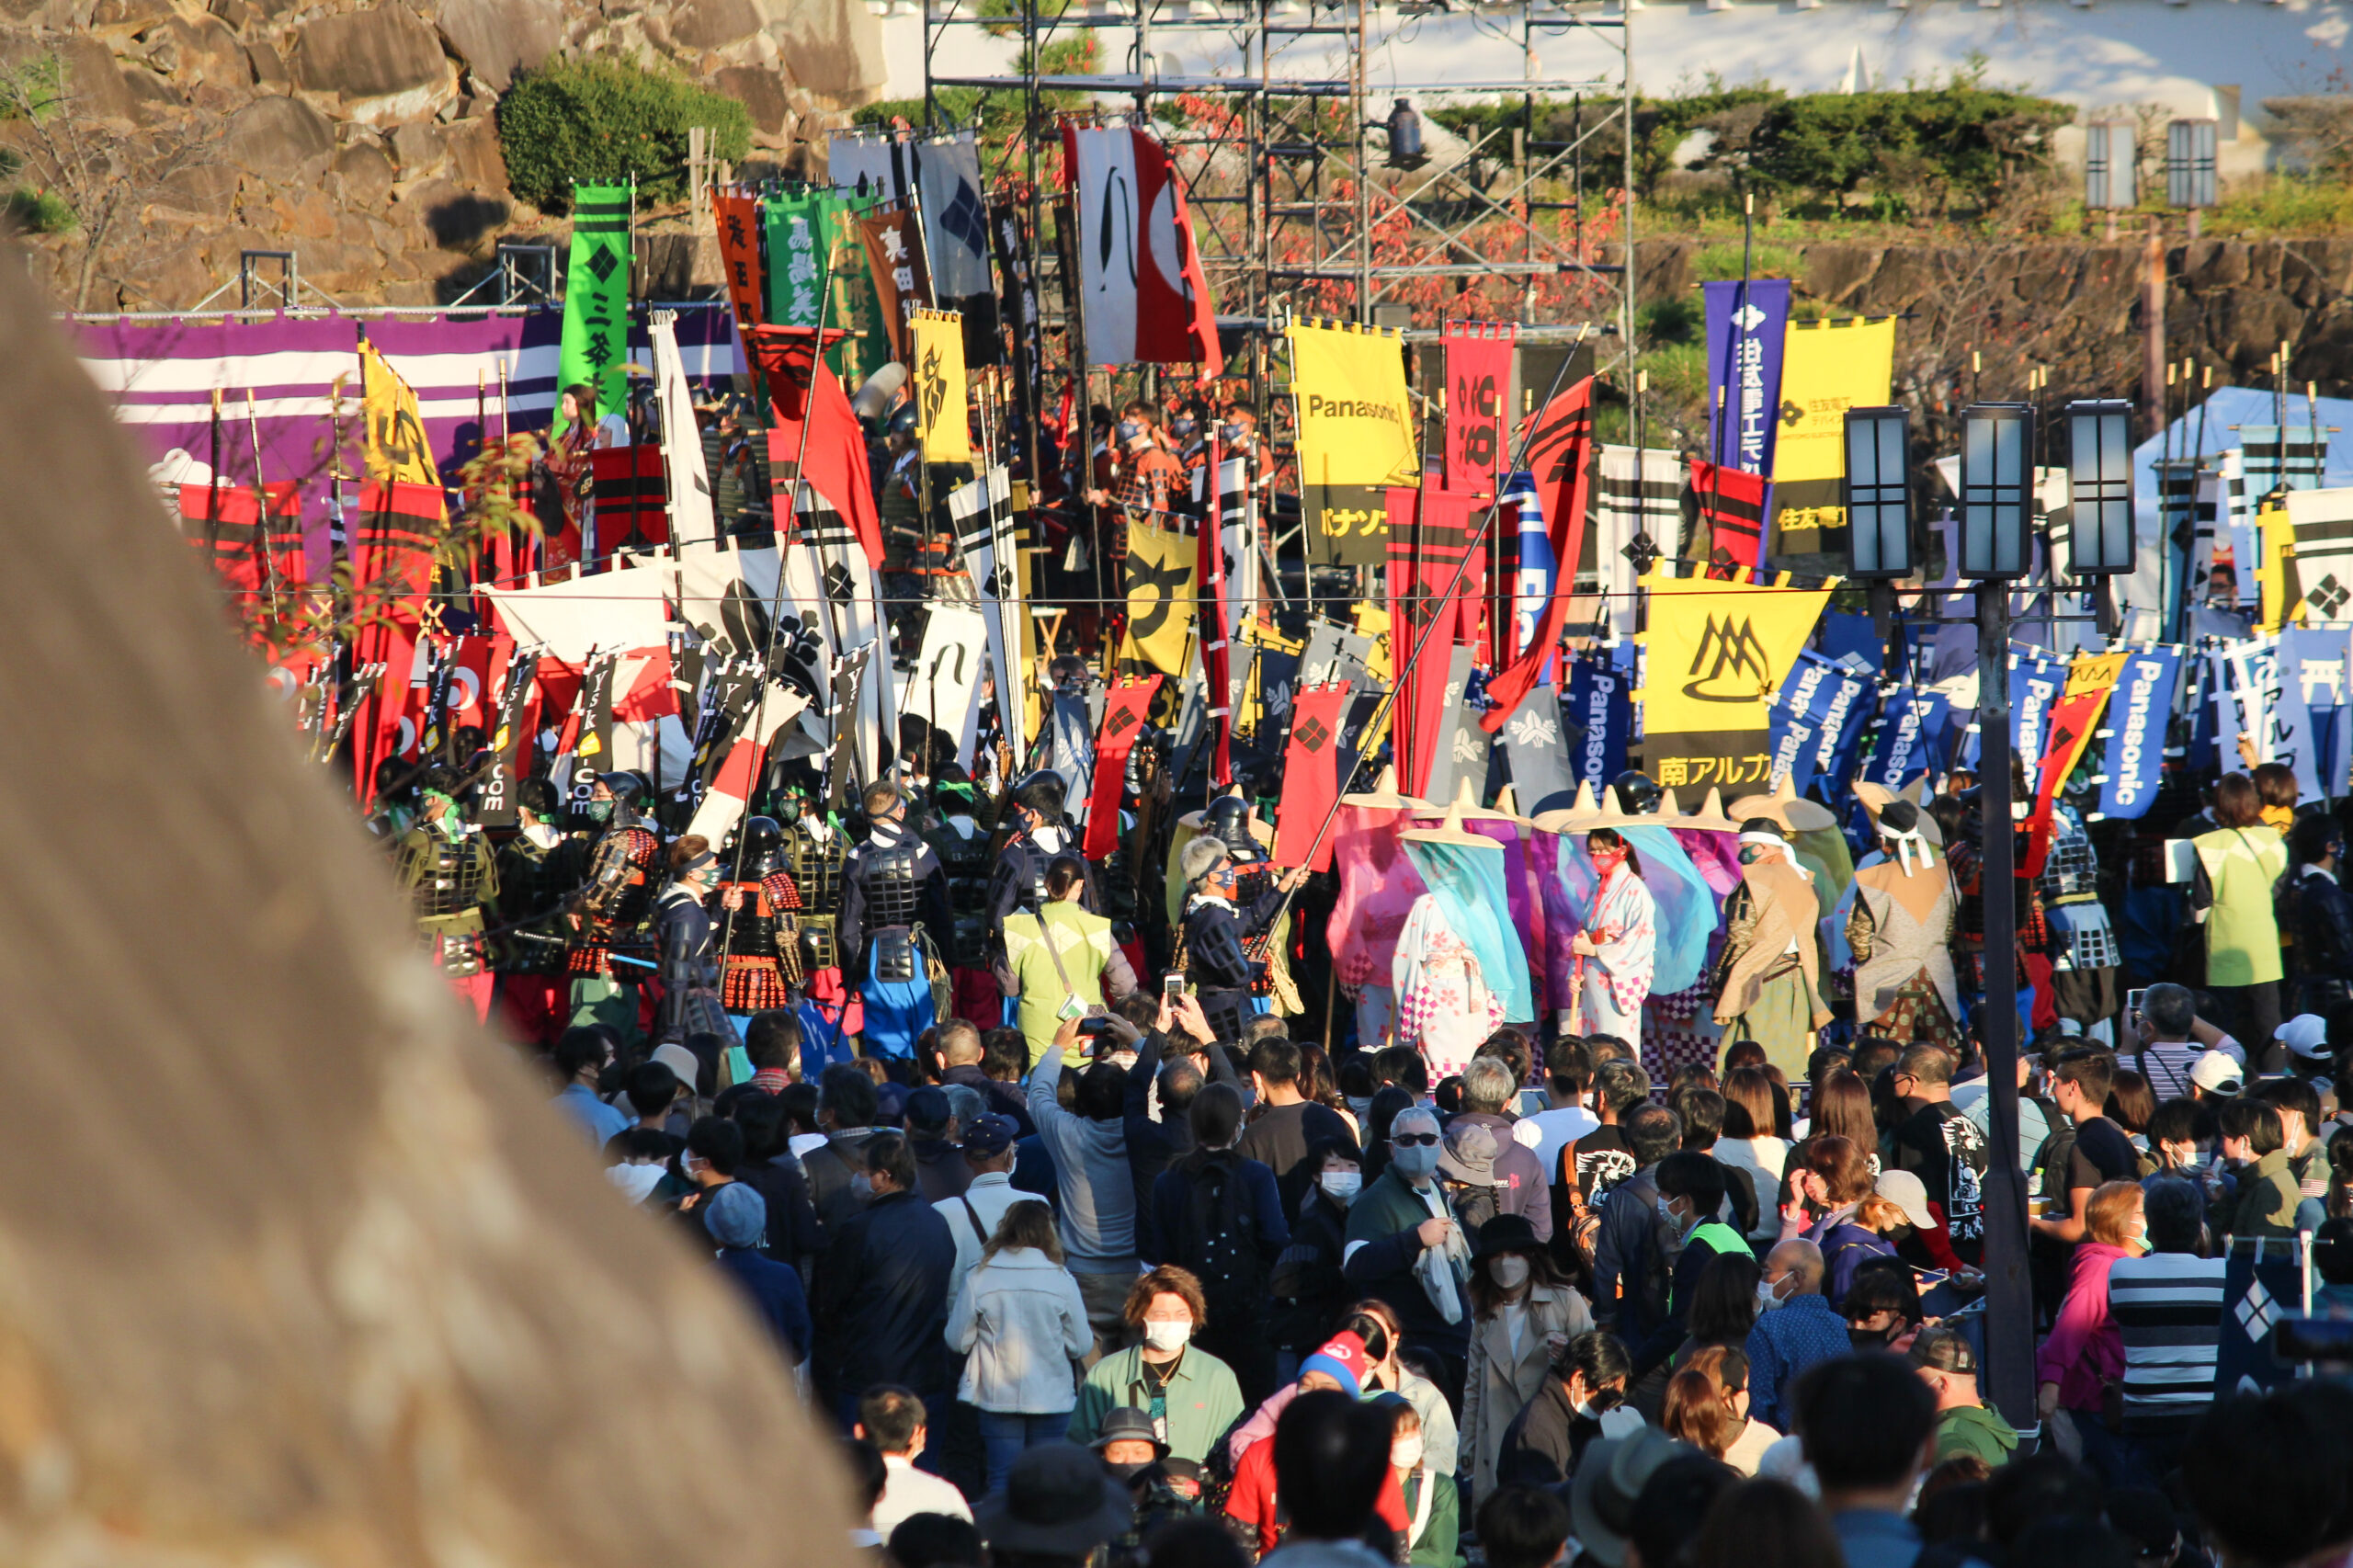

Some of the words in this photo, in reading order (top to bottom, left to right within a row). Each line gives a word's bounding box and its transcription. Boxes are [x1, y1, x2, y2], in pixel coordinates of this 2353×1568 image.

[788, 215, 818, 328] 馬場美
[1309, 394, 1399, 425] Panasonic
[1585, 674, 1615, 808] Panasoni
[2116, 661, 2163, 805] Panasonic
[2264, 687, 2298, 770] アルプ
